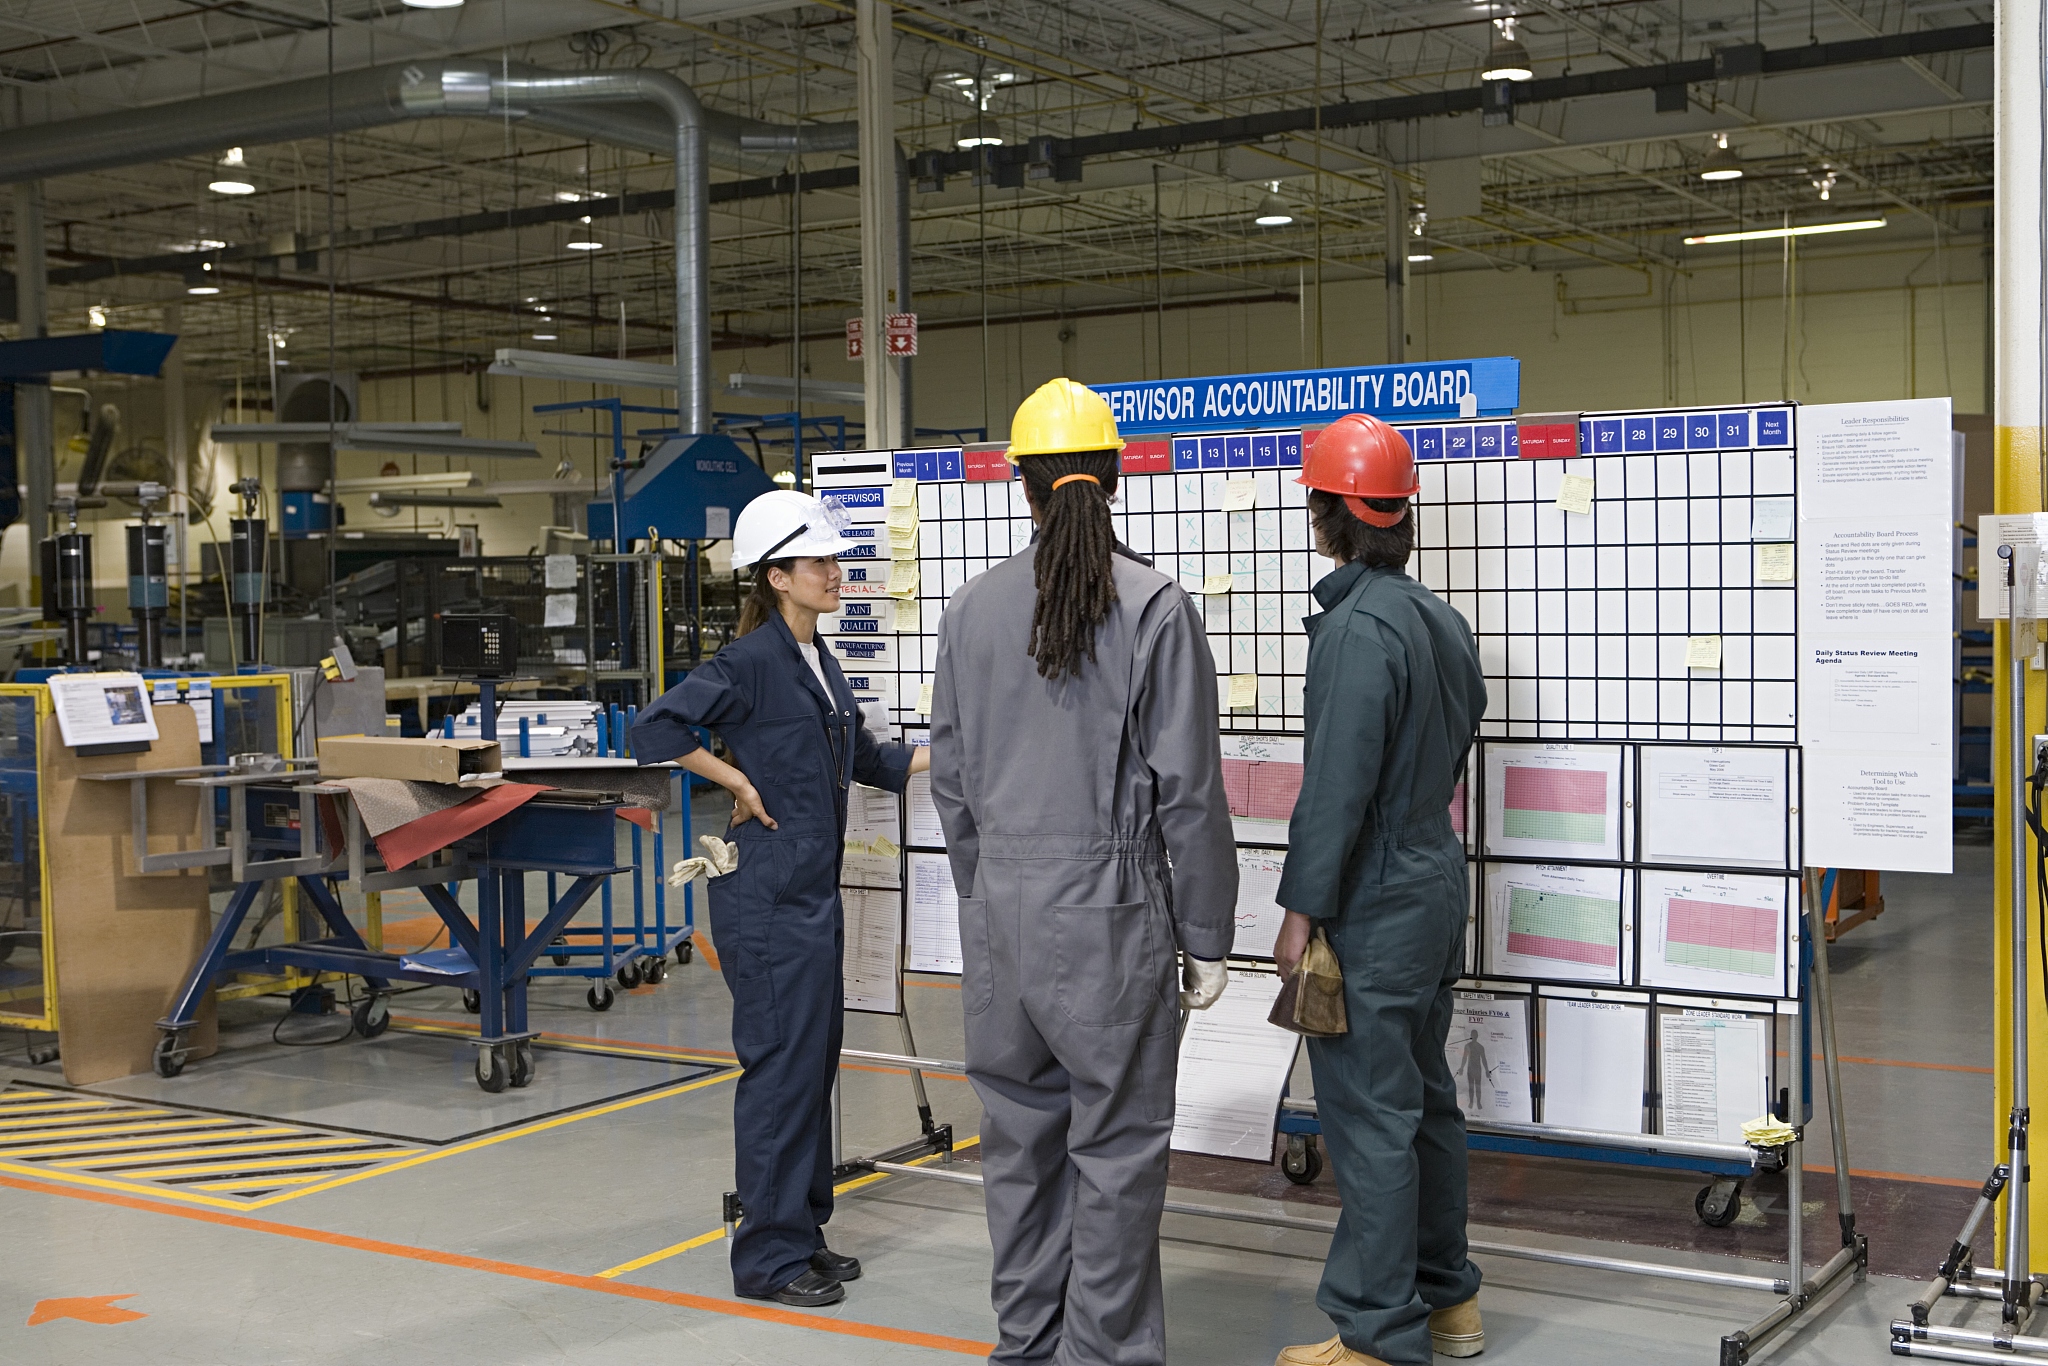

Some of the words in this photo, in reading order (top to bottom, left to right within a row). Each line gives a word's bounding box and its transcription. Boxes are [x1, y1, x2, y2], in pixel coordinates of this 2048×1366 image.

[893, 318, 909, 327] FIRE
[1098, 386, 1195, 422] ERVISOR
[1203, 374, 1385, 418] ACCOUNTABILITY
[1393, 369, 1470, 407] BOARD
[1862, 415, 1909, 425] Responsibilities
[925, 463, 929, 471] 1
[946, 461, 952, 470] 2
[1181, 450, 1193, 460] 12
[1208, 448, 1219, 458] 13
[1233, 448, 1245, 457] 14
[1259, 447, 1271, 456] 15
[1285, 446, 1297, 455] 16
[1423, 439, 1435, 449] 21
[1452, 438, 1466, 447] 22
[1481, 437, 1495, 447] 23
[1511, 436, 1518, 446] 2
[1601, 432, 1615, 442] 27
[1632, 430, 1646, 440] 28
[1663, 428, 1677, 439] 29
[1695, 427, 1709, 437] 30
[1727, 425, 1740, 436] 31
[830, 493, 881, 503] PERVISOR
[837, 547, 876, 556] SPECIALS
[846, 606, 871, 614] PAINT
[840, 622, 878, 631] QUALITY
[835, 642, 886, 650] MANUFACTURING
[1860, 770, 1898, 778] Determining
